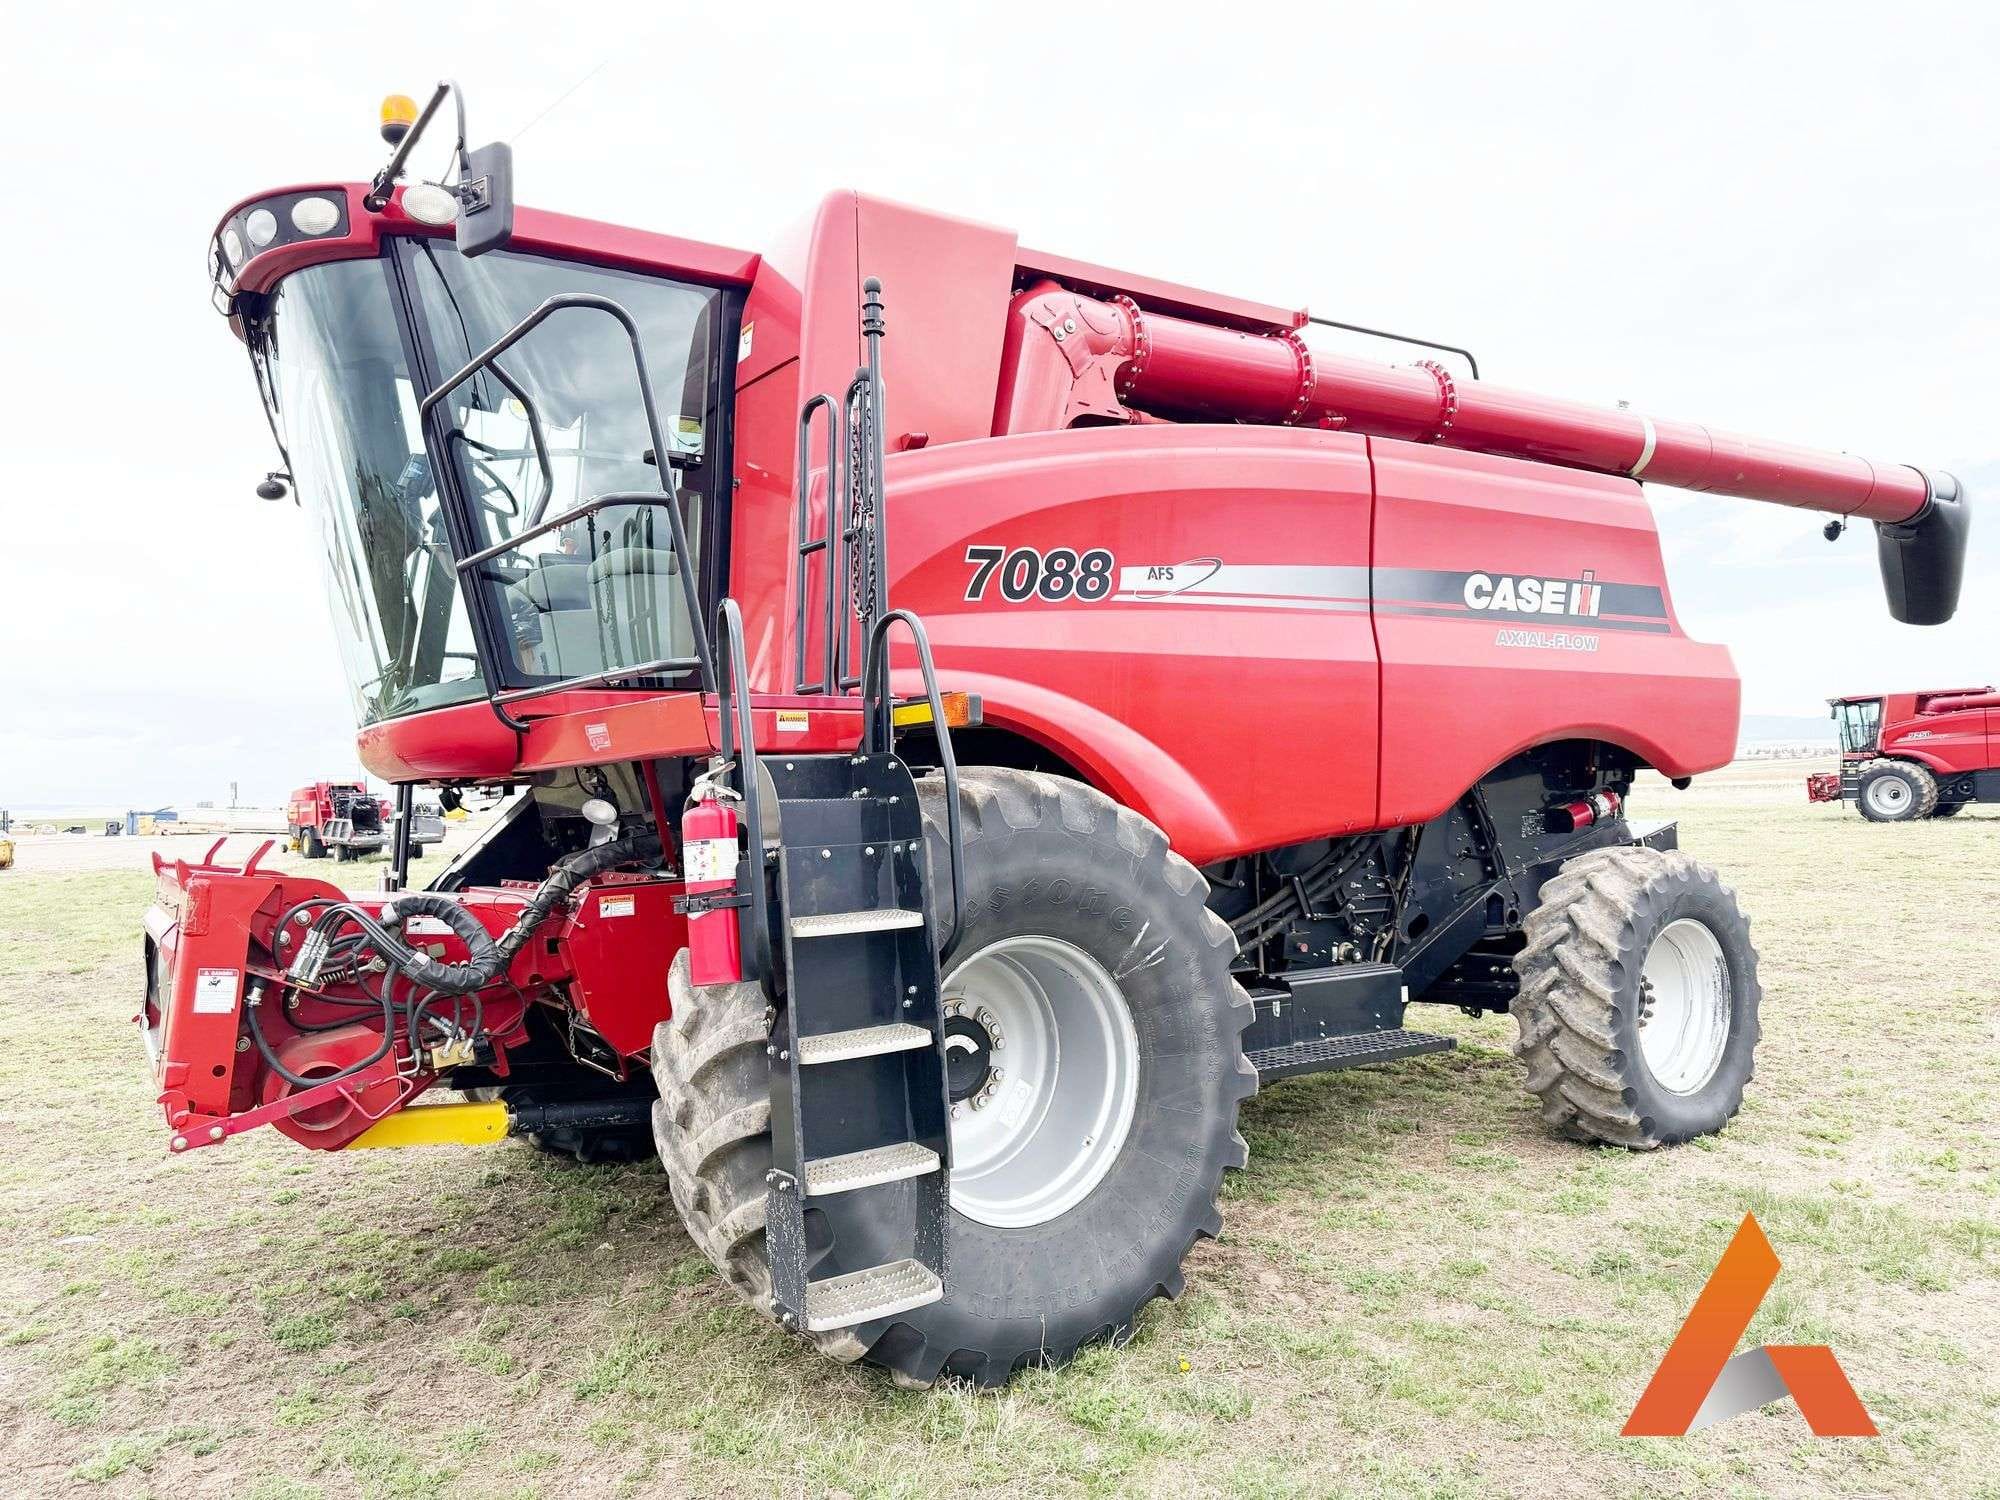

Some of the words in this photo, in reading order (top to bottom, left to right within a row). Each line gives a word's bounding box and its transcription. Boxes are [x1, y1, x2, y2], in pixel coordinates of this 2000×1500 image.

[964, 545, 1115, 601] 7088
[1146, 565, 1175, 581] AFS
[1463, 572, 1567, 614] CASE
[1496, 629, 1599, 651] AXIAL-FLOW
